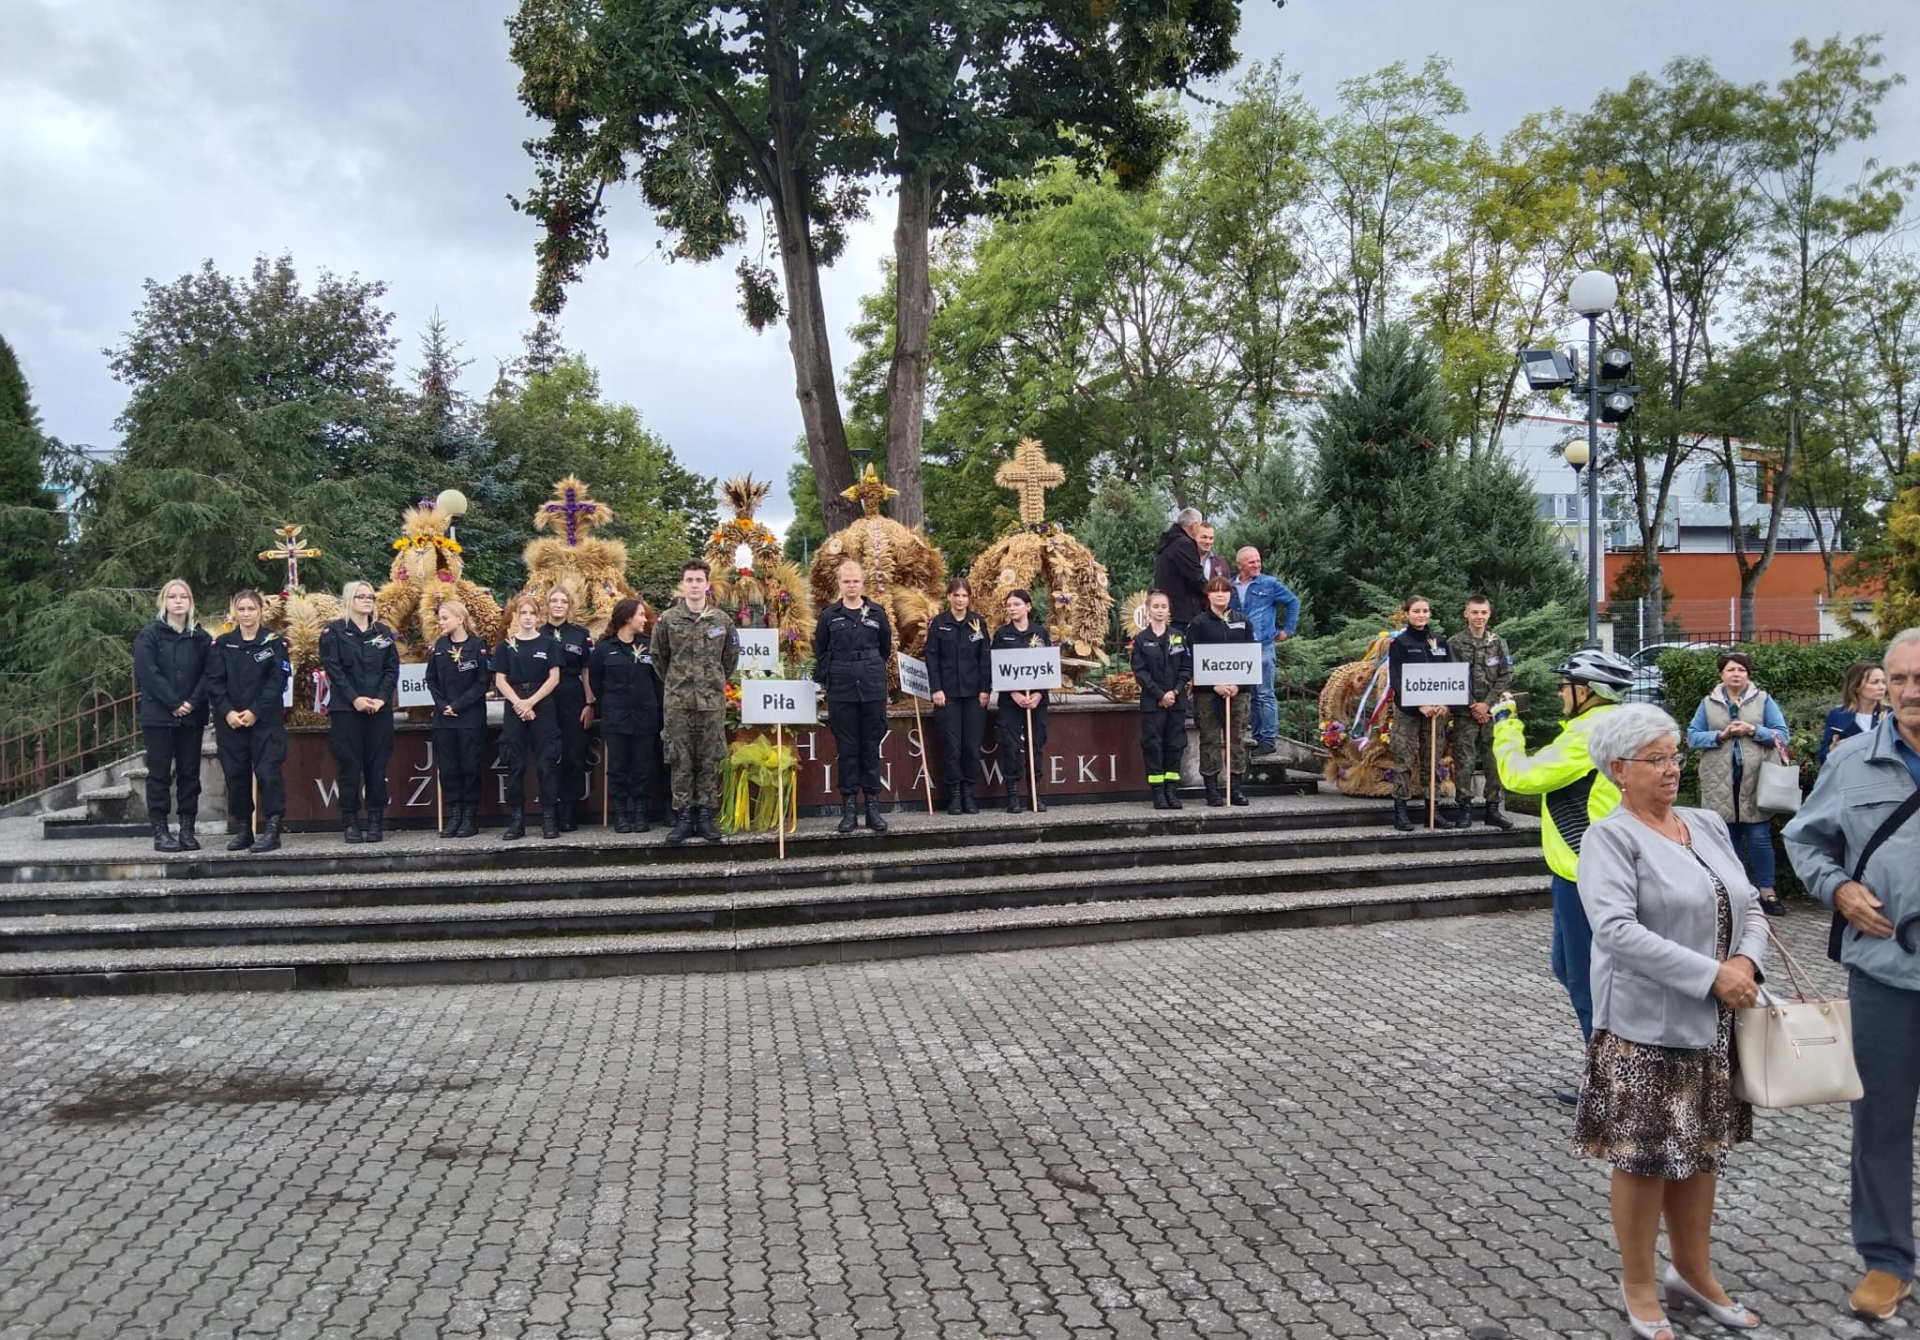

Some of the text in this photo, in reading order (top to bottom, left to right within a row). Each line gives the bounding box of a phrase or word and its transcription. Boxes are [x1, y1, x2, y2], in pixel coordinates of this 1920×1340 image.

[740, 643, 770, 657] soka
[999, 661, 1055, 681] Wyrzysk
[1201, 658, 1254, 674] Kaczory
[402, 679, 428, 692] Biał
[1405, 677, 1466, 692] Łobżenica
[763, 693, 796, 709] Piła
[979, 754, 1117, 787] WEKI
